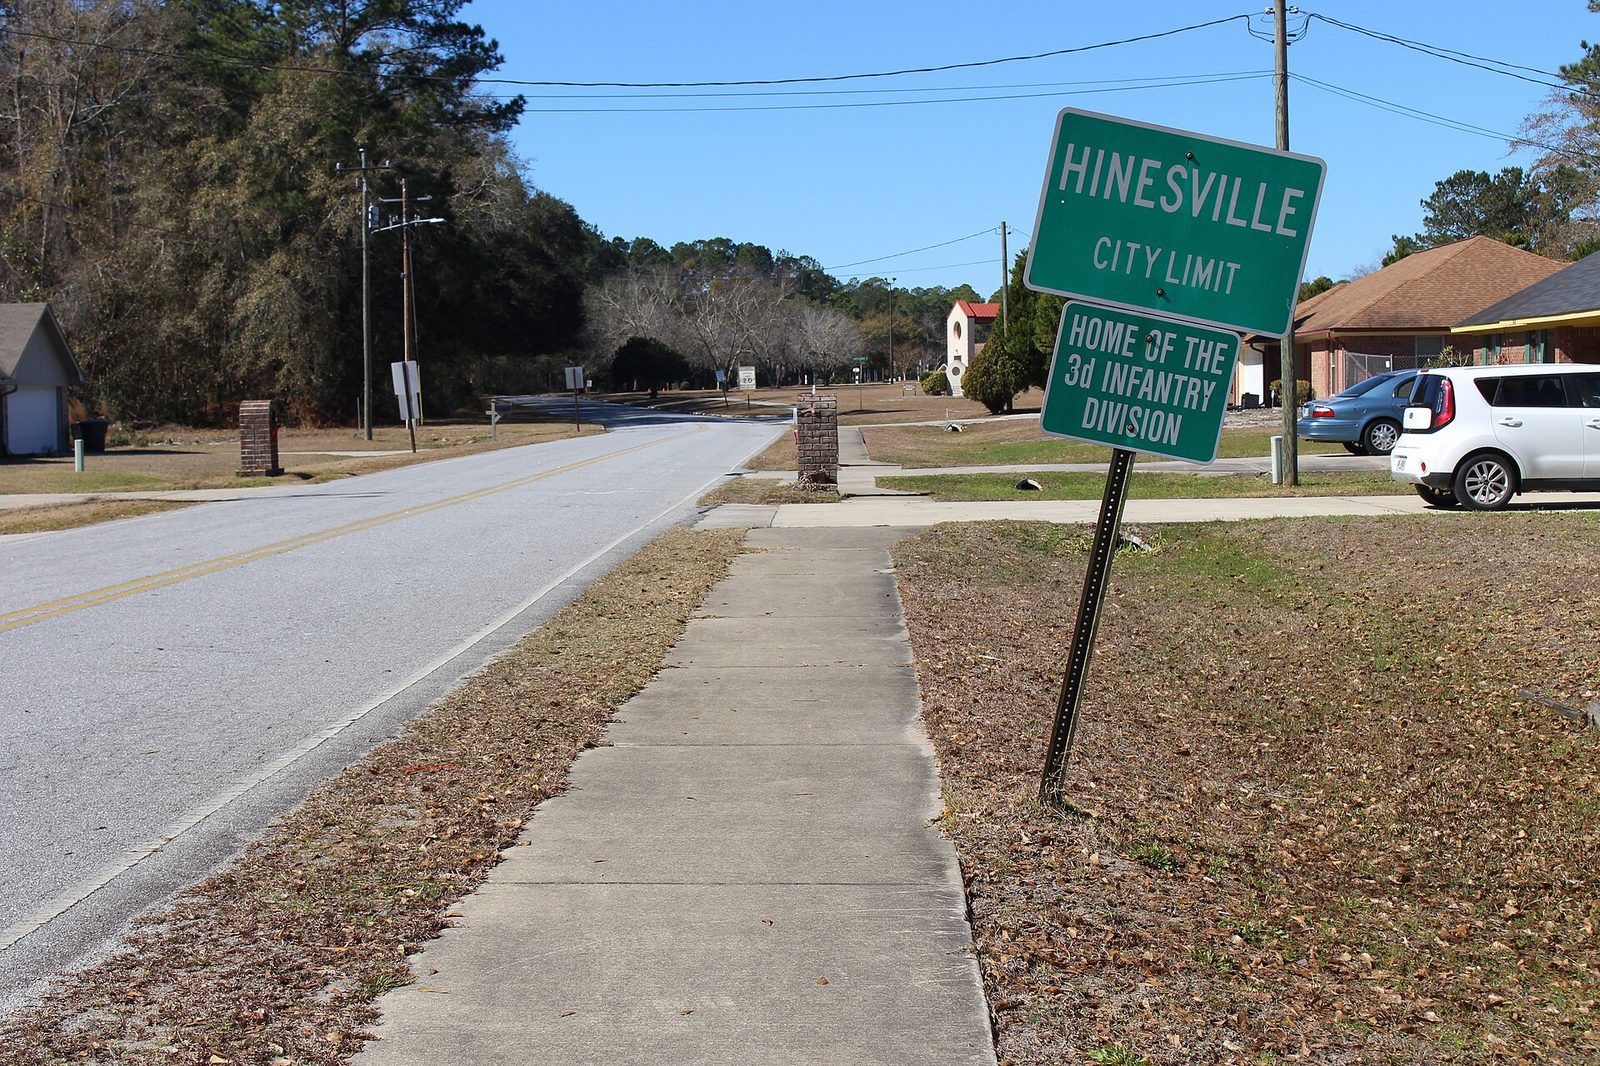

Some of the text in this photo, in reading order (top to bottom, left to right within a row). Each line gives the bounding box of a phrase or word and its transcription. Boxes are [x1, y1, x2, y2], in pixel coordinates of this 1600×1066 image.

[1058, 143, 1304, 237] HINESVILLE
[1093, 236, 1241, 294] CITY LIMIT
[1068, 314, 1228, 375] HOME OF THE
[1065, 354, 1216, 412] 3d INFANTRY
[1081, 397, 1183, 446] DIVISION
